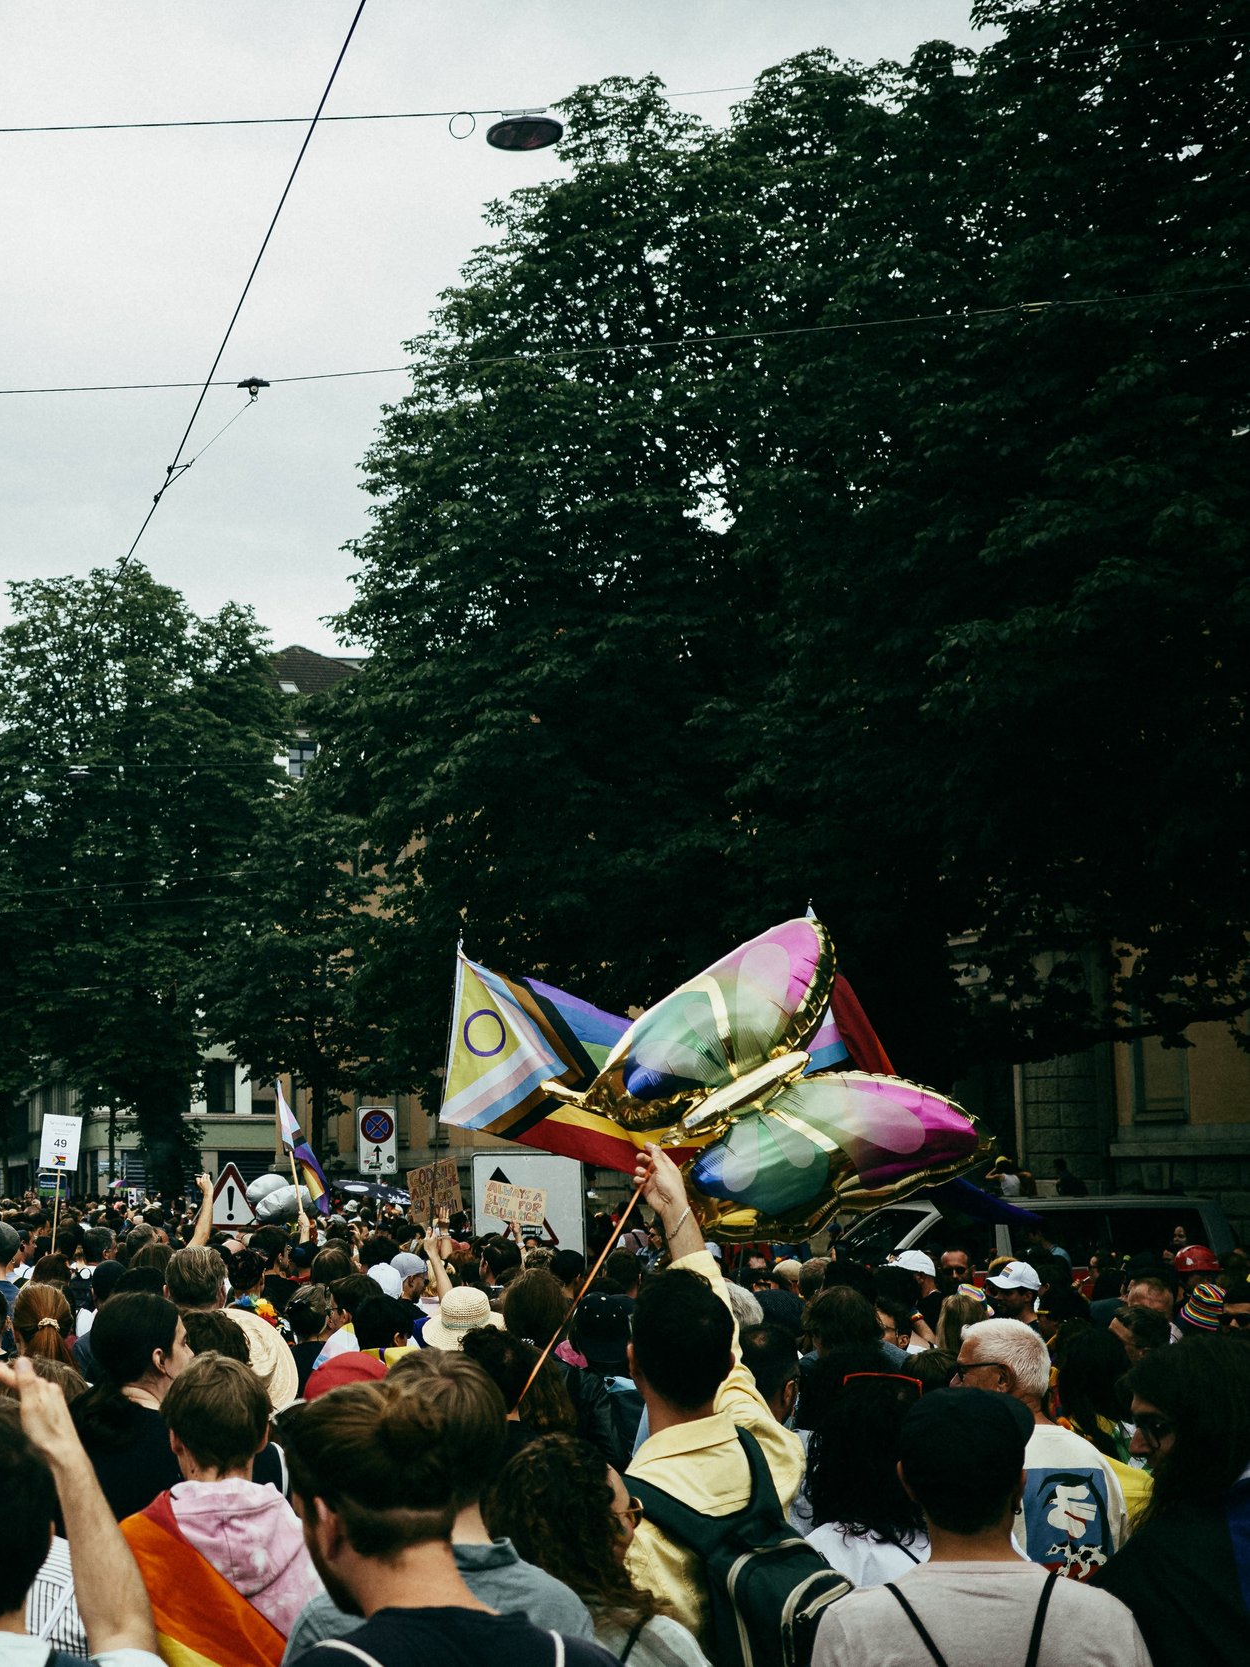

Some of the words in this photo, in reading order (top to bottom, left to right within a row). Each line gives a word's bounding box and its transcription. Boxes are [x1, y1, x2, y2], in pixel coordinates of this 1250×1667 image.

[53, 1139, 67, 1148] 49
[410, 1168, 433, 1188] GOD
[487, 1182, 531, 1199] ALWAYS
[533, 1192, 542, 1201] A
[486, 1193, 510, 1207] SLUT
[518, 1200, 541, 1212] FOR
